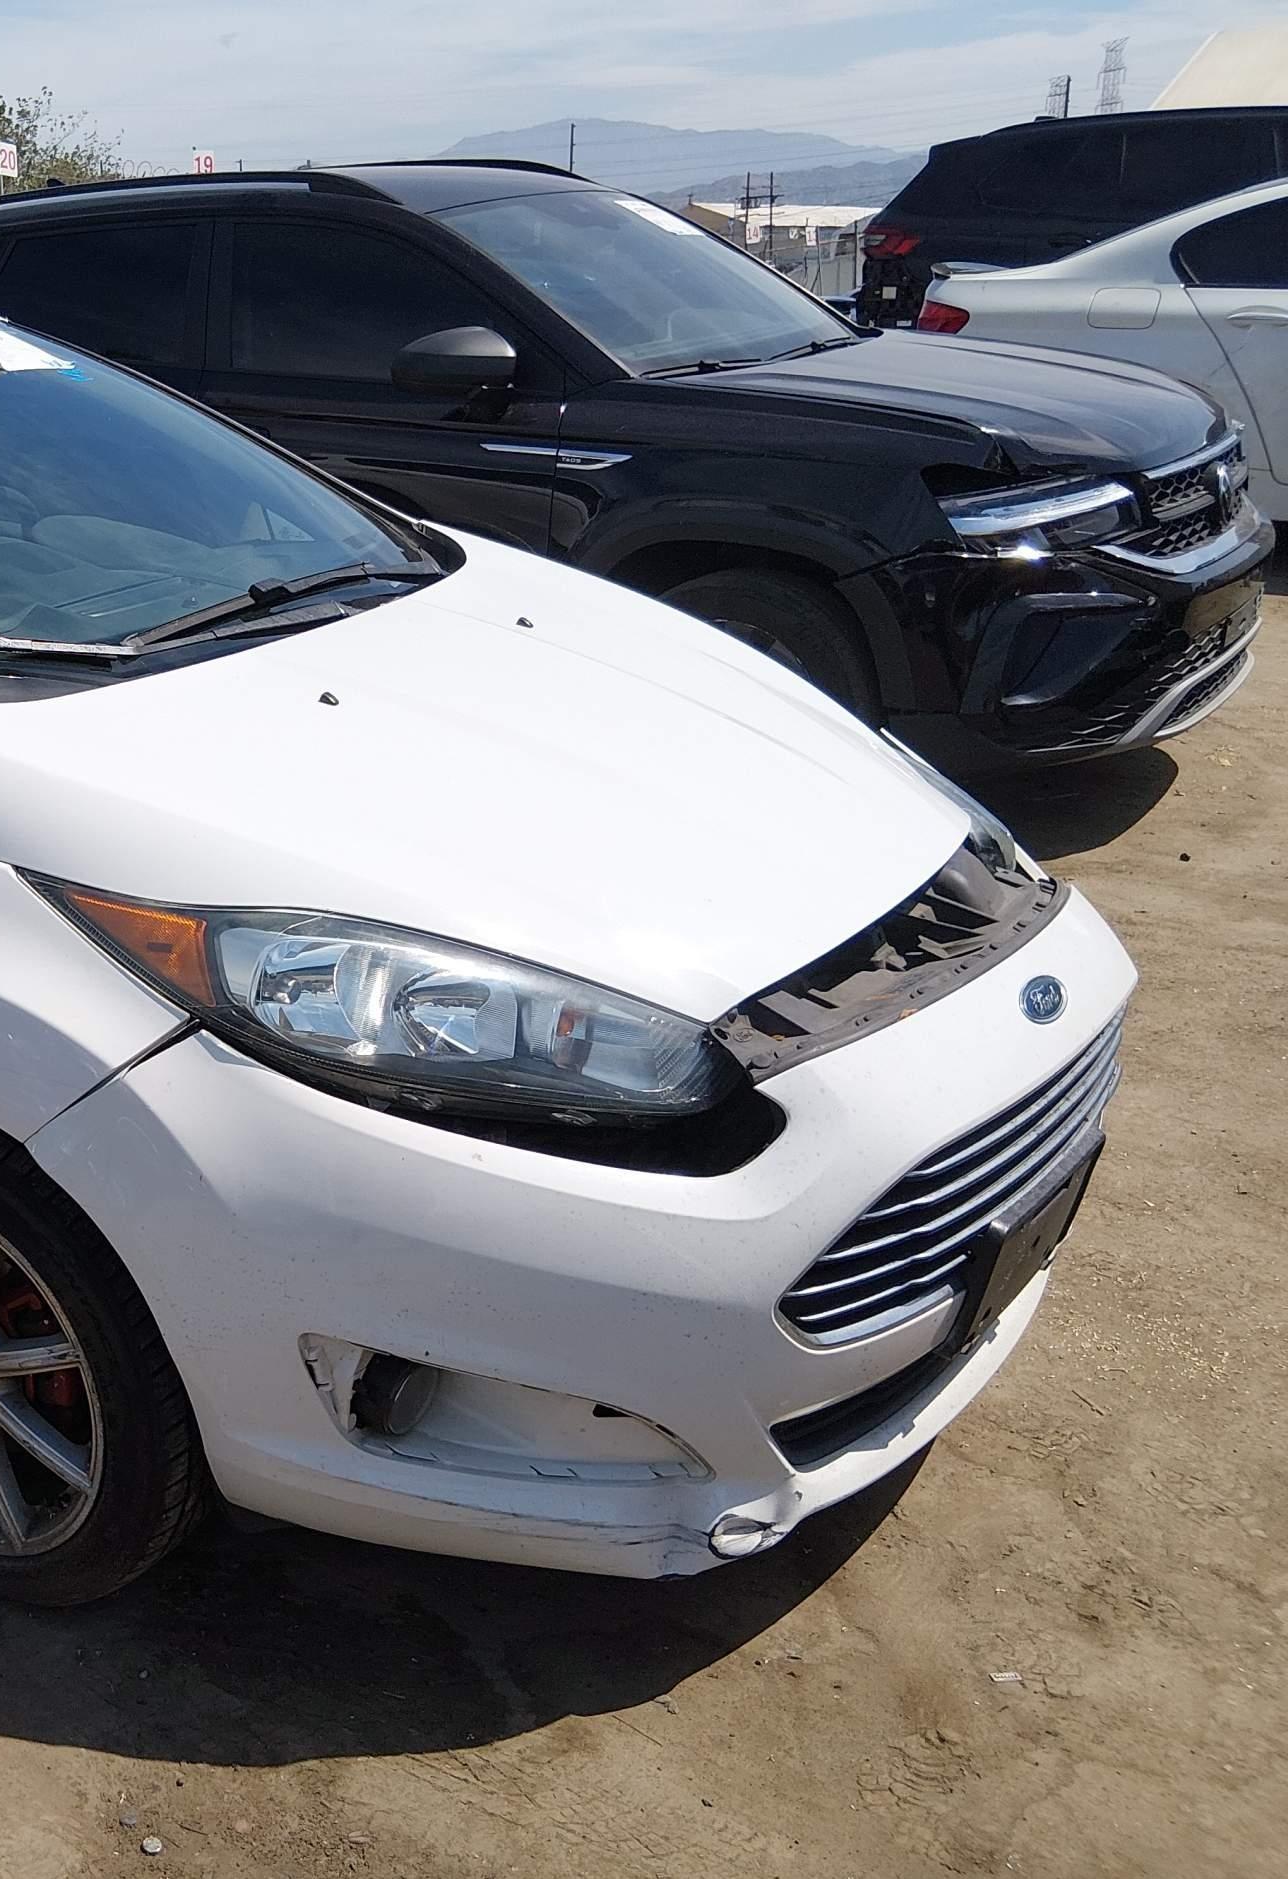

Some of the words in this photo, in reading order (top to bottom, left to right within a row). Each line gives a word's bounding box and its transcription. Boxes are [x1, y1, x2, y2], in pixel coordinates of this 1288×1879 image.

[0, 148, 16, 170] 20
[194, 155, 213, 174] 19
[746, 225, 760, 240] 14
[1029, 983, 1061, 1014] Ford
